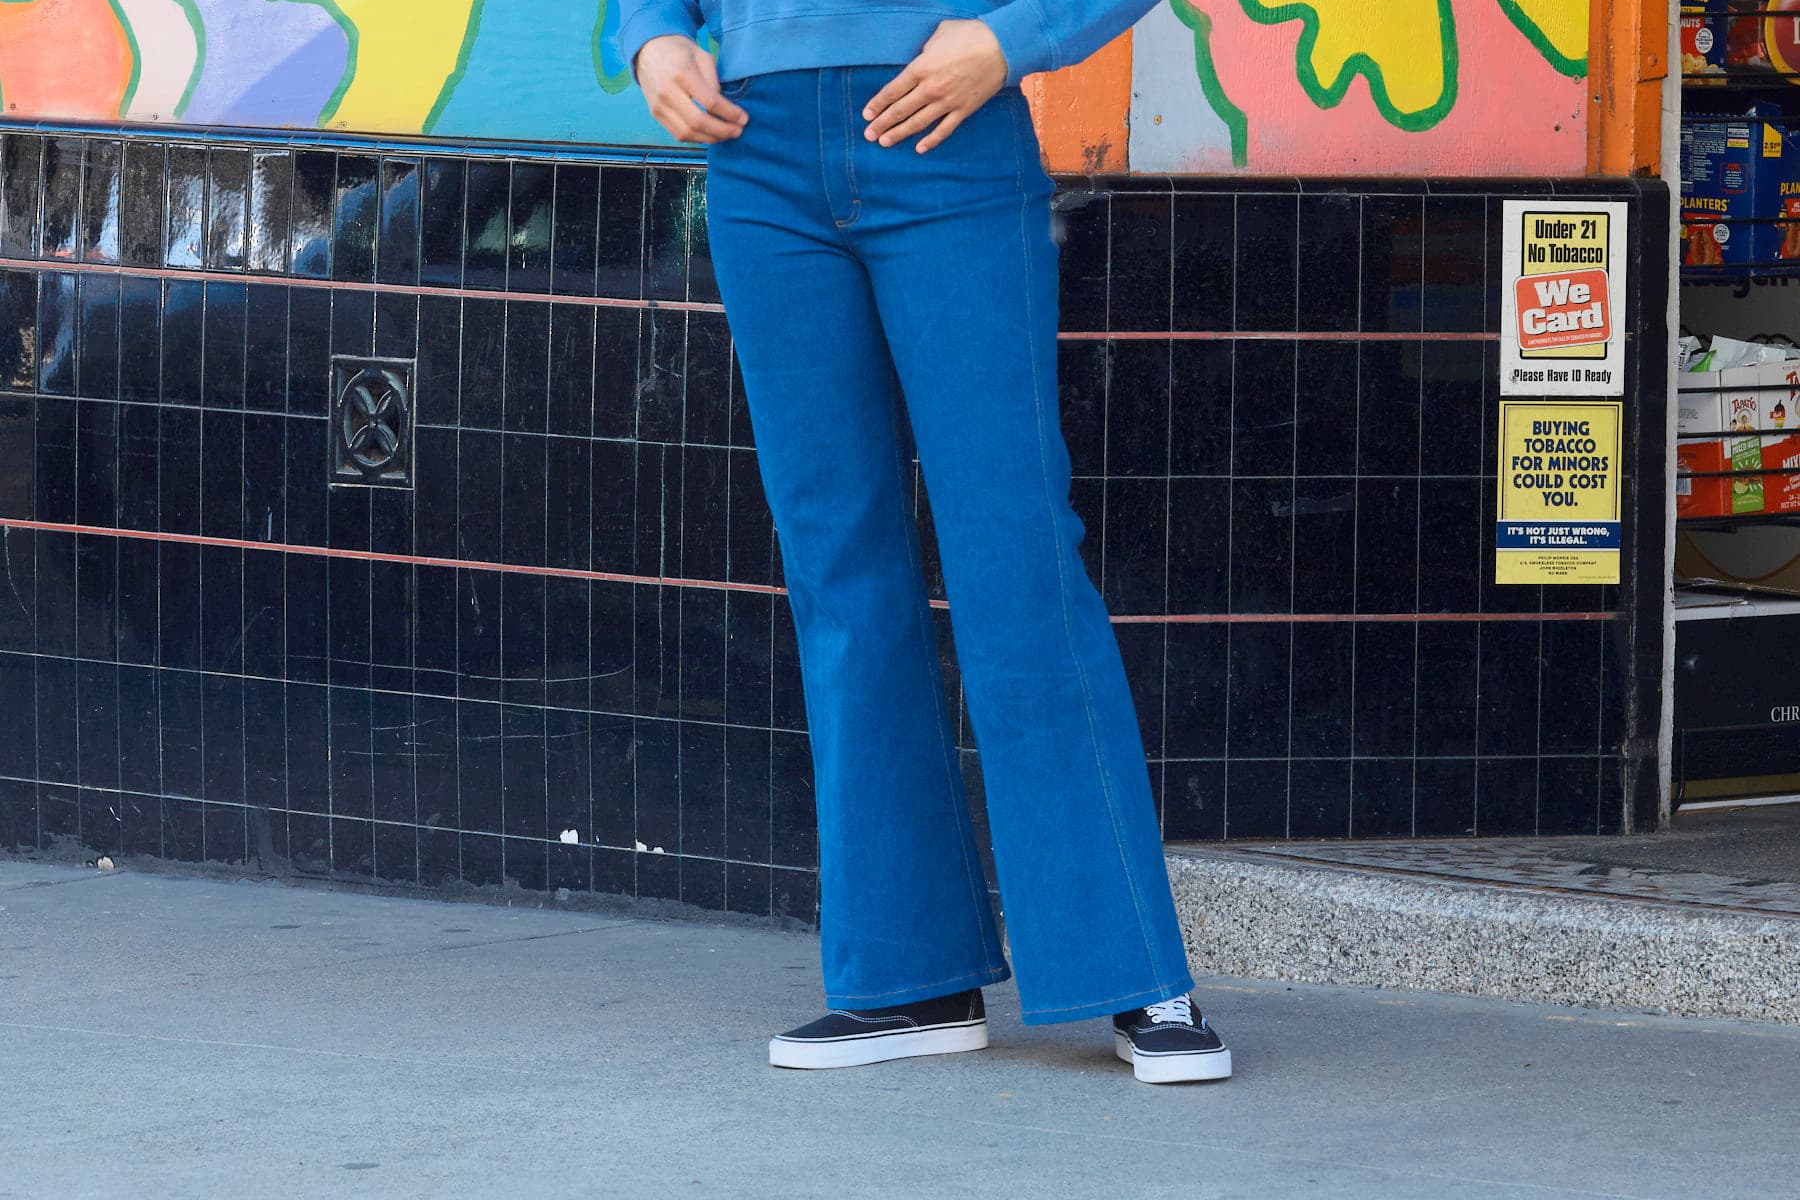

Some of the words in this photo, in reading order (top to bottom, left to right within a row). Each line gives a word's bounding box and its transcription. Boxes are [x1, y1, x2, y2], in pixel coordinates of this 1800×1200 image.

[1536, 220, 1576, 239] Under
[1580, 220, 1596, 239] 21
[1528, 244, 1546, 262] No
[1549, 244, 1603, 263] Tobacco
[1534, 279, 1590, 308] We
[1522, 302, 1604, 335] Card
[1514, 369, 1544, 382] Please
[1548, 369, 1570, 382] Have
[1572, 369, 1582, 382] ID
[1585, 369, 1612, 384] Ready
[1533, 421, 1589, 436] BUYING
[1524, 439, 1596, 454] TOBACCO
[1512, 456, 1542, 471] FOR
[1548, 456, 1608, 472] MINORS
[1513, 474, 1564, 489] COULD
[1569, 474, 1607, 489] COST
[1542, 492, 1578, 507] YOU.
[1507, 527, 1524, 535] IT'S
[1526, 527, 1546, 535] NOT
[1547, 527, 1570, 535] JUST
[1572, 527, 1610, 537] WRONG,
[1529, 536, 1546, 544] IT'S
[1548, 536, 1587, 544] ILLEGAL.
[1770, 706, 1800, 722] CHR
